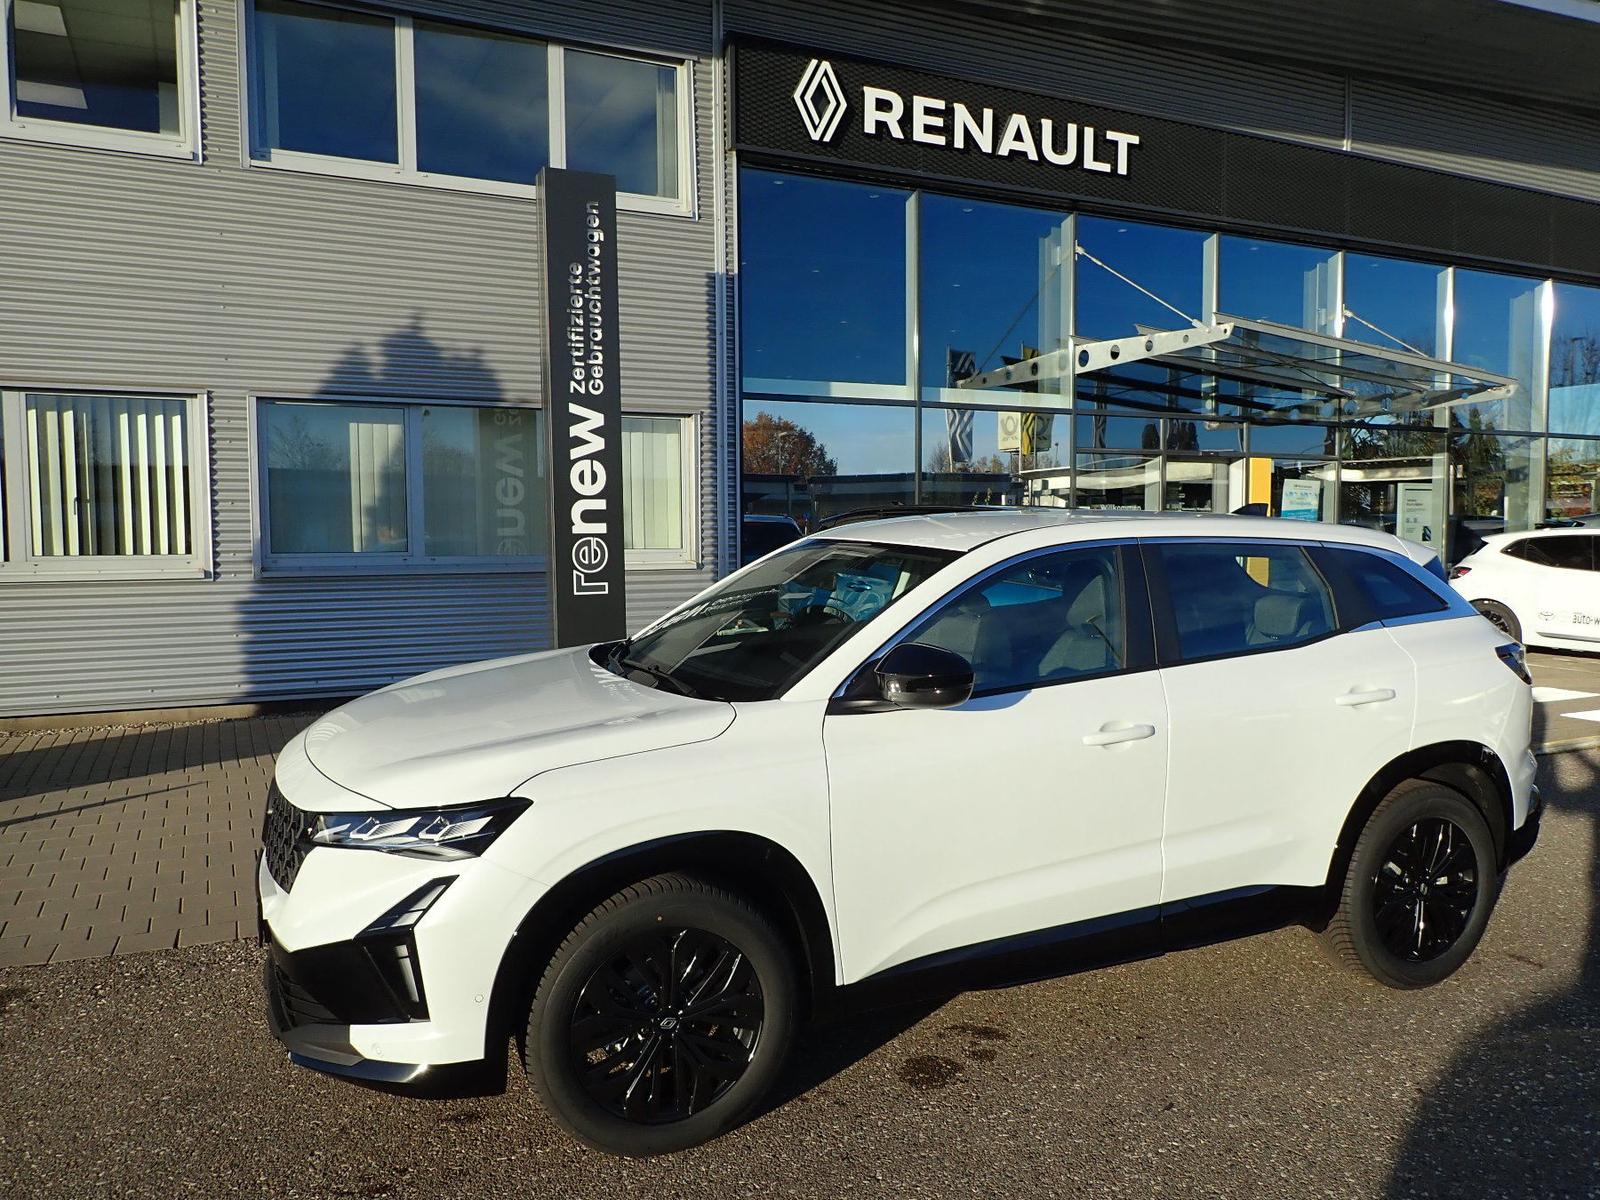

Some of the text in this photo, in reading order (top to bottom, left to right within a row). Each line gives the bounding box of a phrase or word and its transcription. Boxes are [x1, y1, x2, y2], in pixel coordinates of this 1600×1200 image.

[863, 86, 1140, 176] RENAULT
[567, 262, 586, 395] Zertifizierte
[585, 201, 605, 396] Gebrauchtwagen
[568, 402, 609, 595] renew
